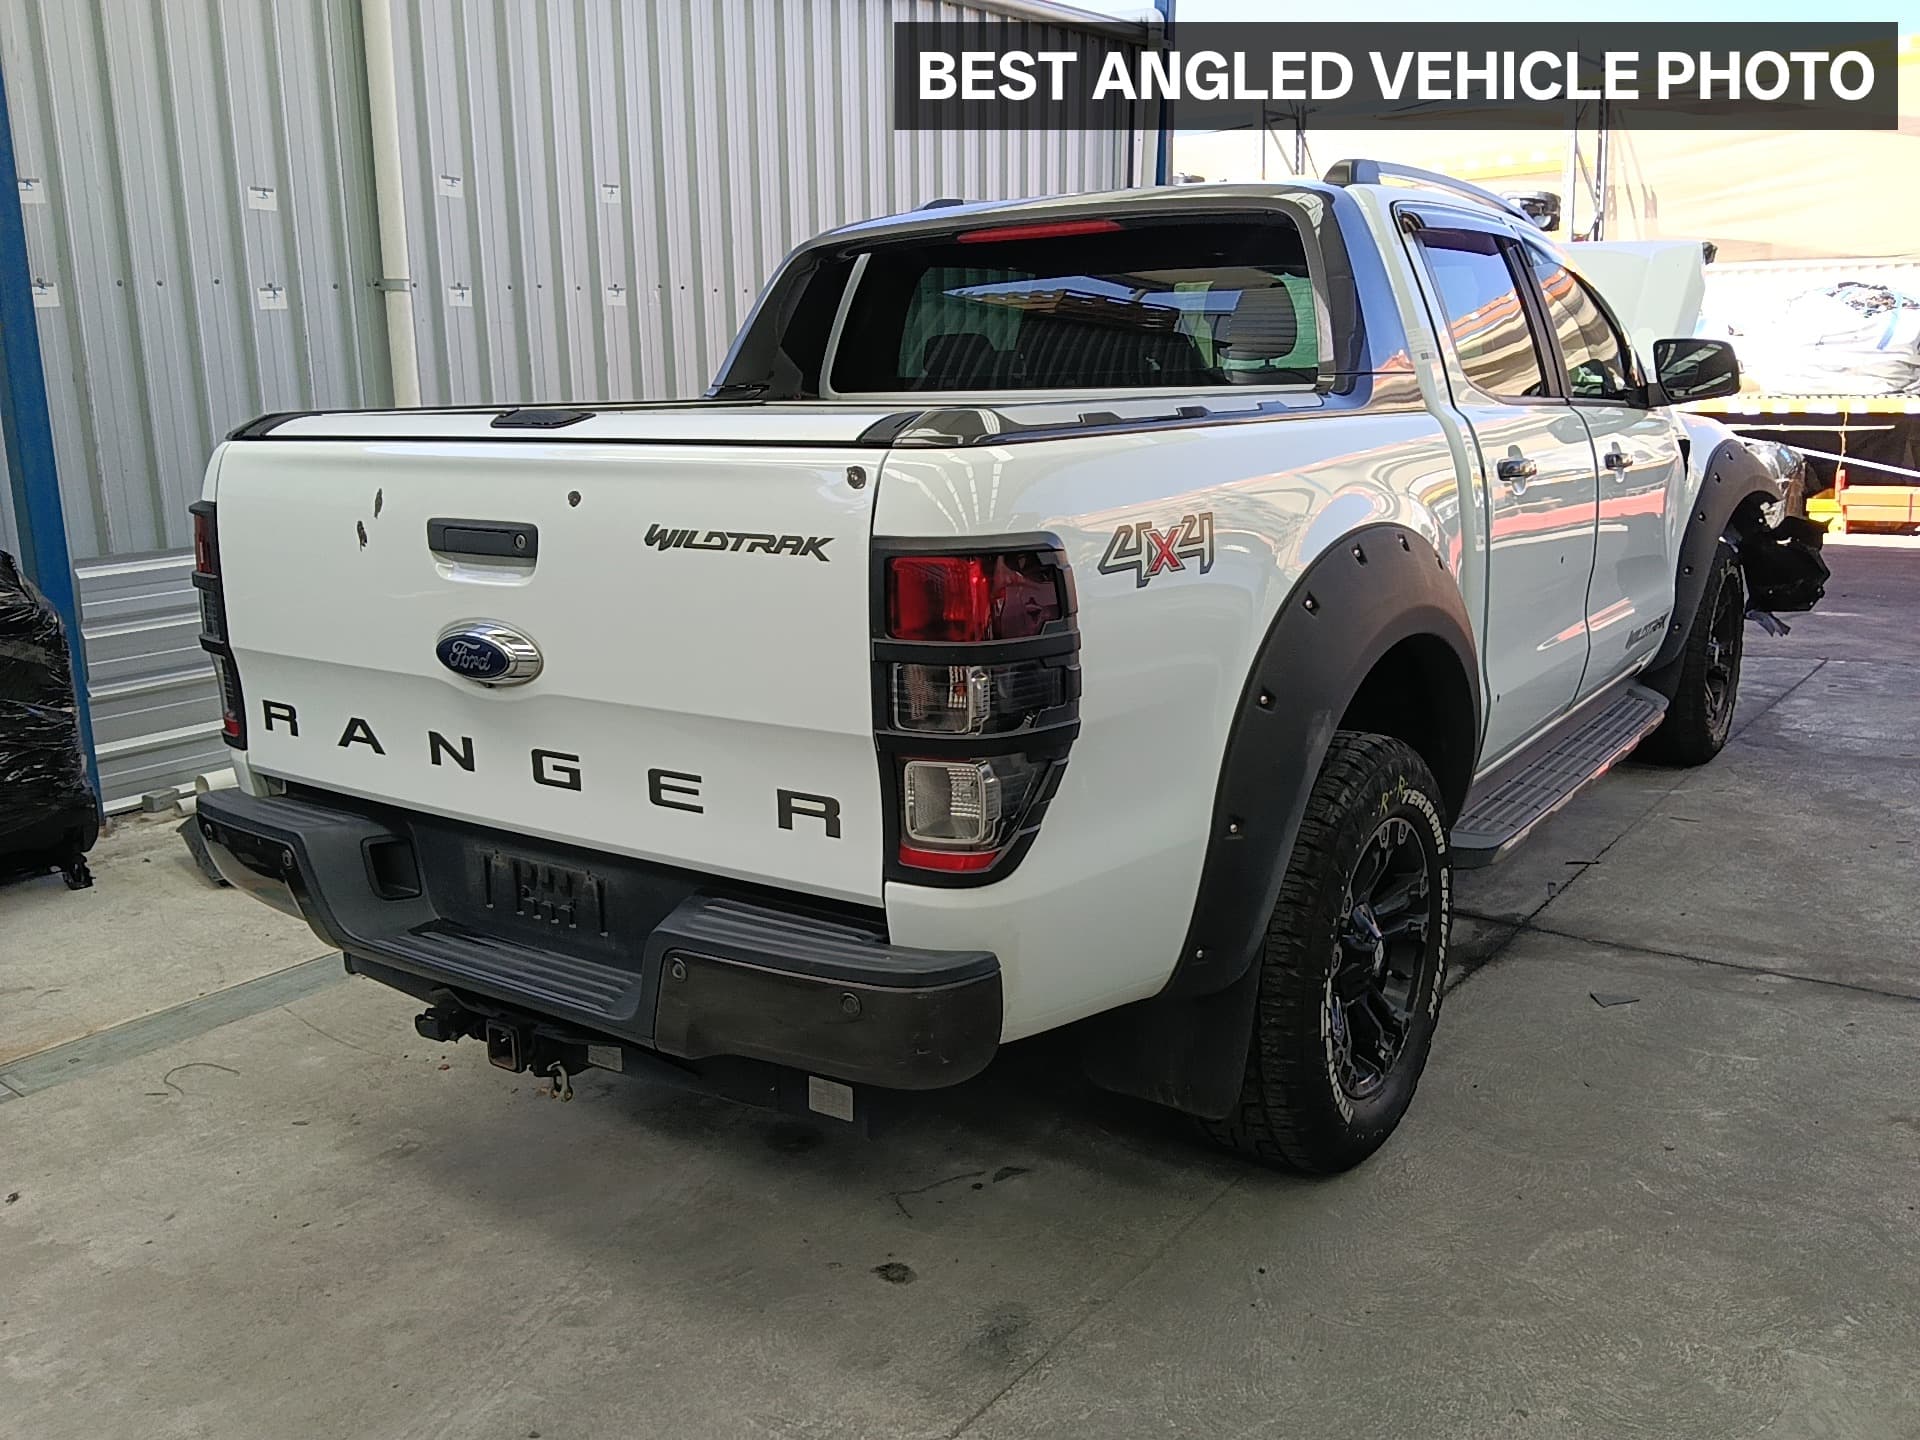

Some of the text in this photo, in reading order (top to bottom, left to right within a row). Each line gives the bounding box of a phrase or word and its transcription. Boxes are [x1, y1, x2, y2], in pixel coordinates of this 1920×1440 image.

[644, 524, 835, 562] WILDTRAK
[449, 641, 491, 671] Ford
[263, 699, 841, 839] RANGER
[1401, 788, 1446, 855] TERRAIN
